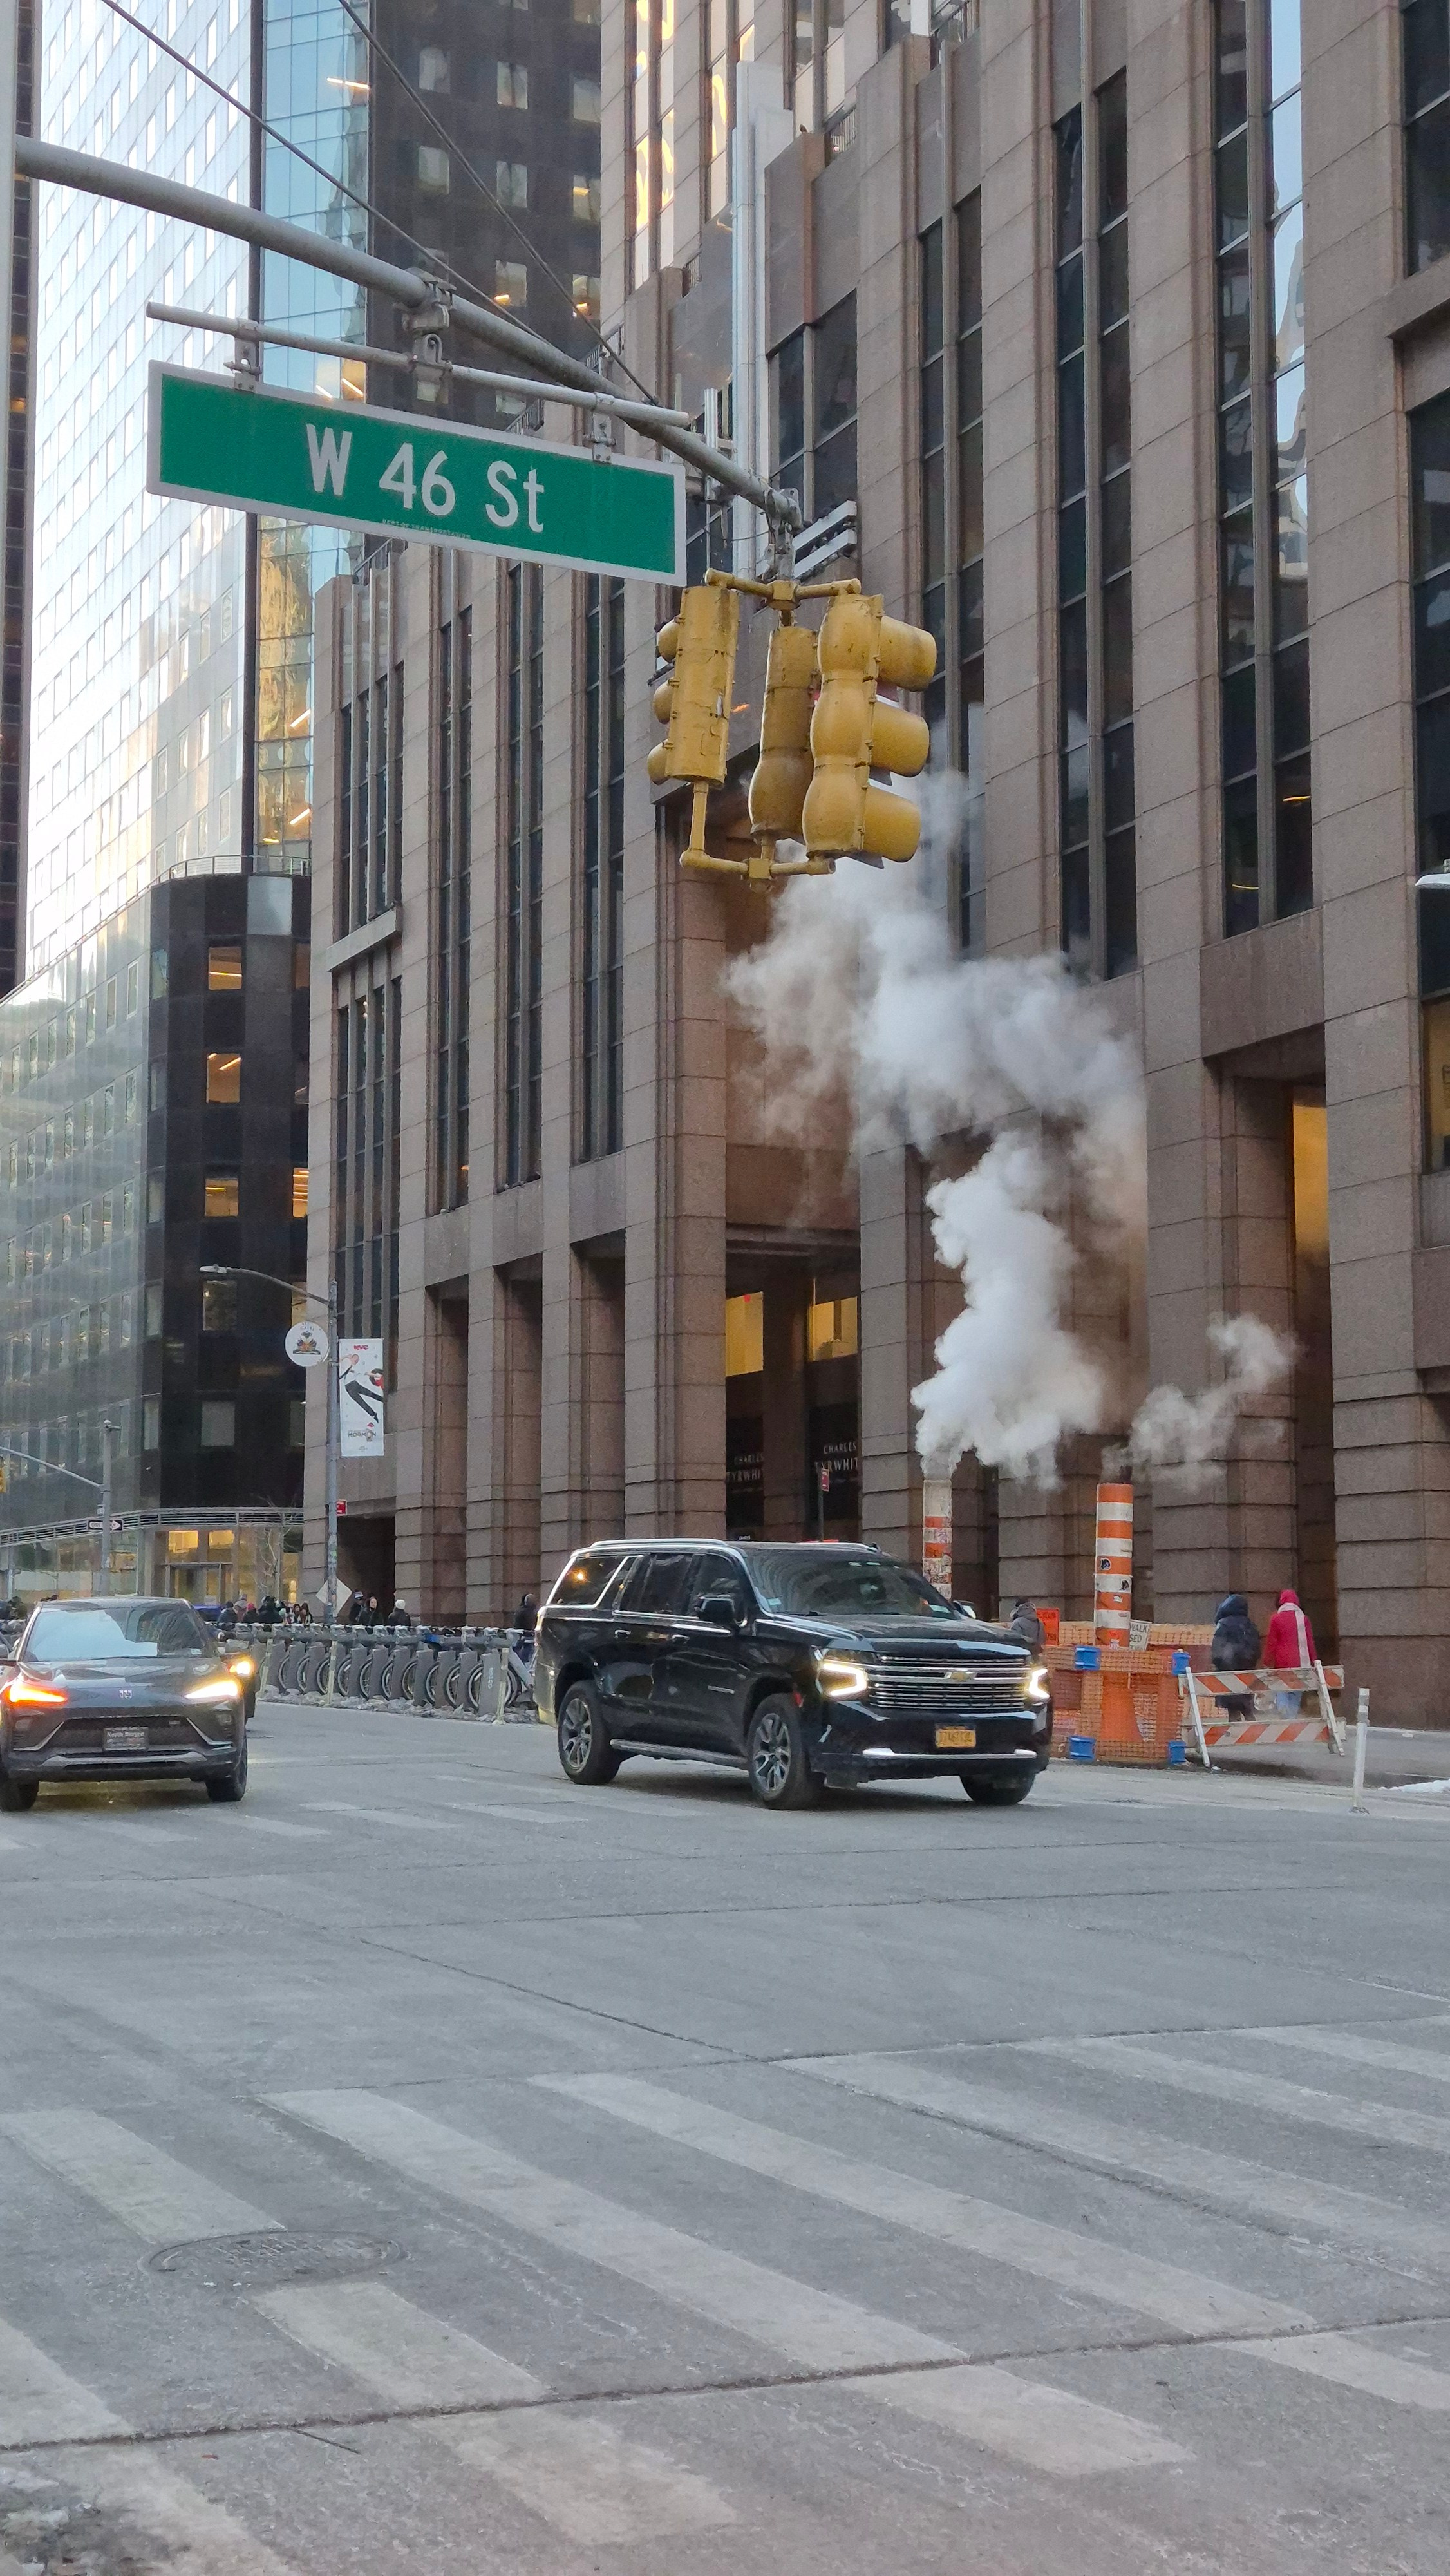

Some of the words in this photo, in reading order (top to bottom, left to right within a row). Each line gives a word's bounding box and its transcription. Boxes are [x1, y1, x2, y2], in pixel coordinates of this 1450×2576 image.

[306, 423, 352, 496] W
[379, 442, 456, 516] 46
[485, 460, 544, 533] St
[824, 1441, 856, 1454] CHARLES
